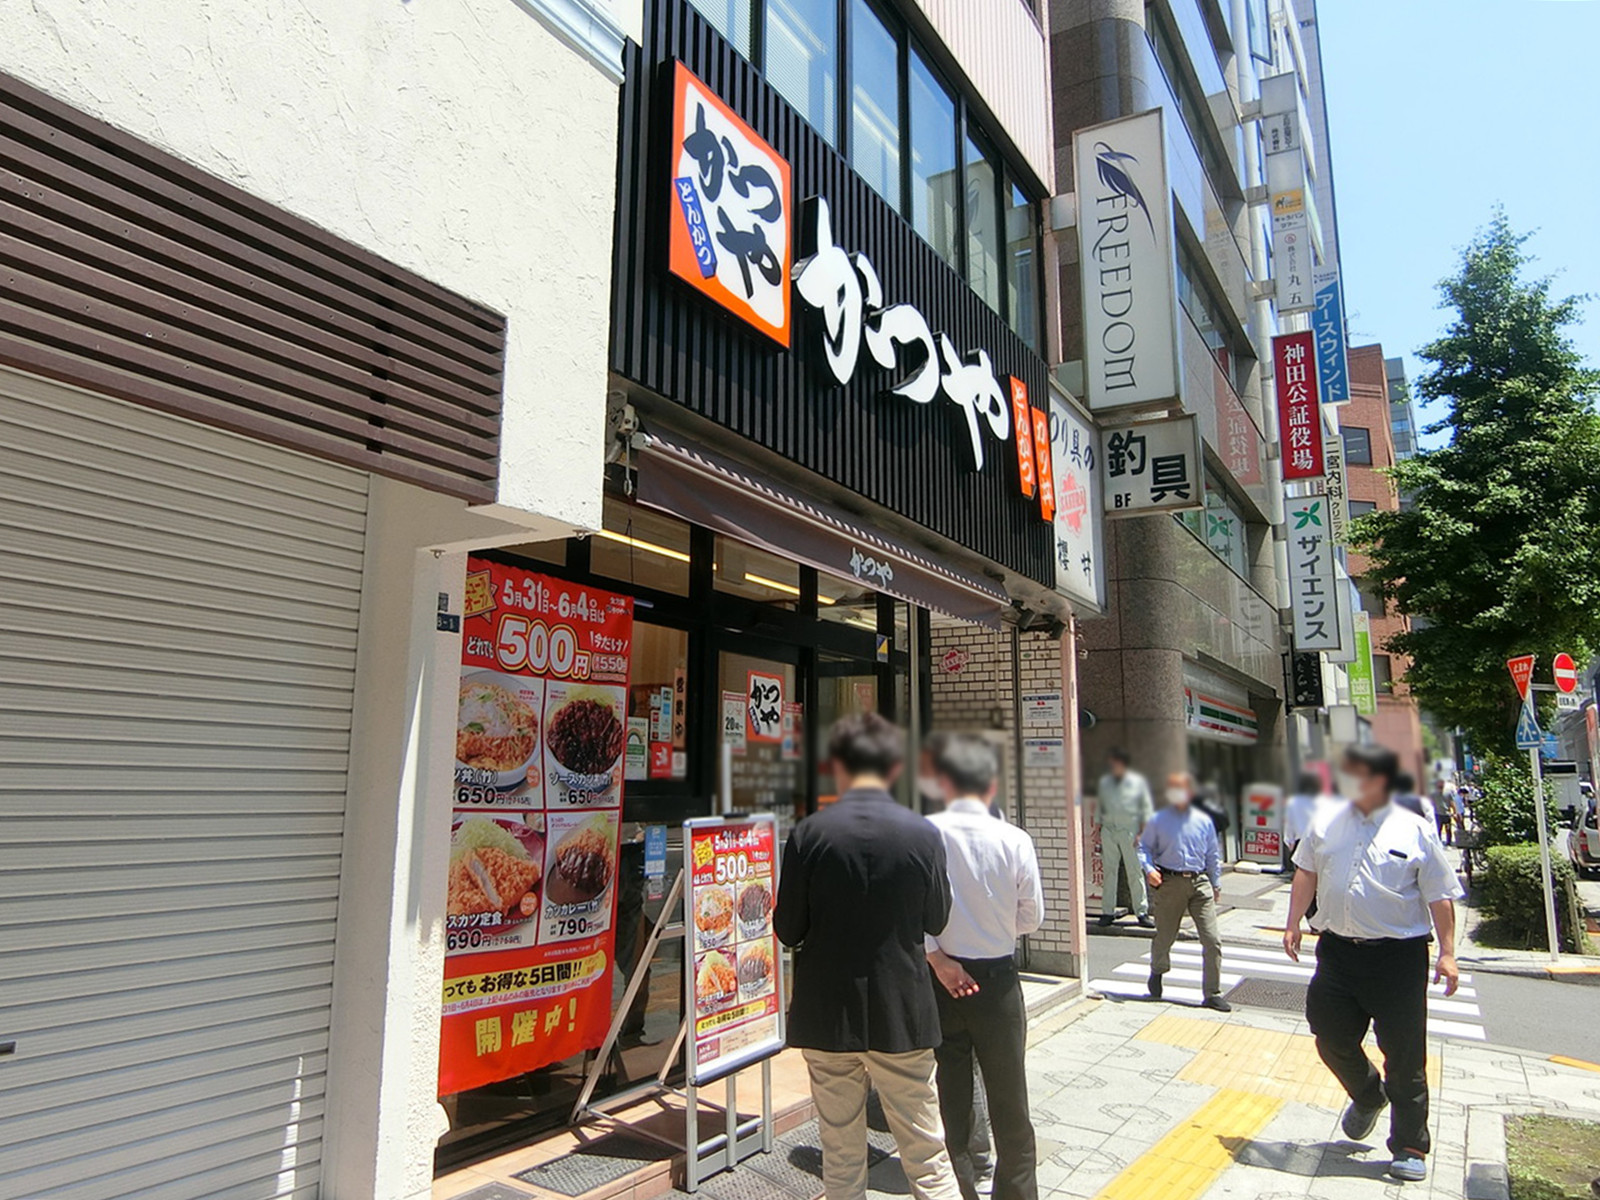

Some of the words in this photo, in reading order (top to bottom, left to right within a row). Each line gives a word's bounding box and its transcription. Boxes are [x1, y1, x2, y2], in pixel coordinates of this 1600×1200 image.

[678, 182, 712, 265] とんかつ
[682, 102, 783, 299] かつや
[793, 194, 1010, 472] かつや
[1091, 191, 1138, 392] FREEDOM
[1316, 293, 1342, 402] アースウィンド
[1014, 383, 1032, 483] とんかつ
[1283, 344, 1314, 470] 神田公証役場
[1107, 430, 1191, 503] 釣具
[1114, 494, 1132, 508] BF
[849, 547, 893, 588] かつや
[1297, 536, 1329, 641] ザイエンス
[496, 615, 590, 679] 500円
